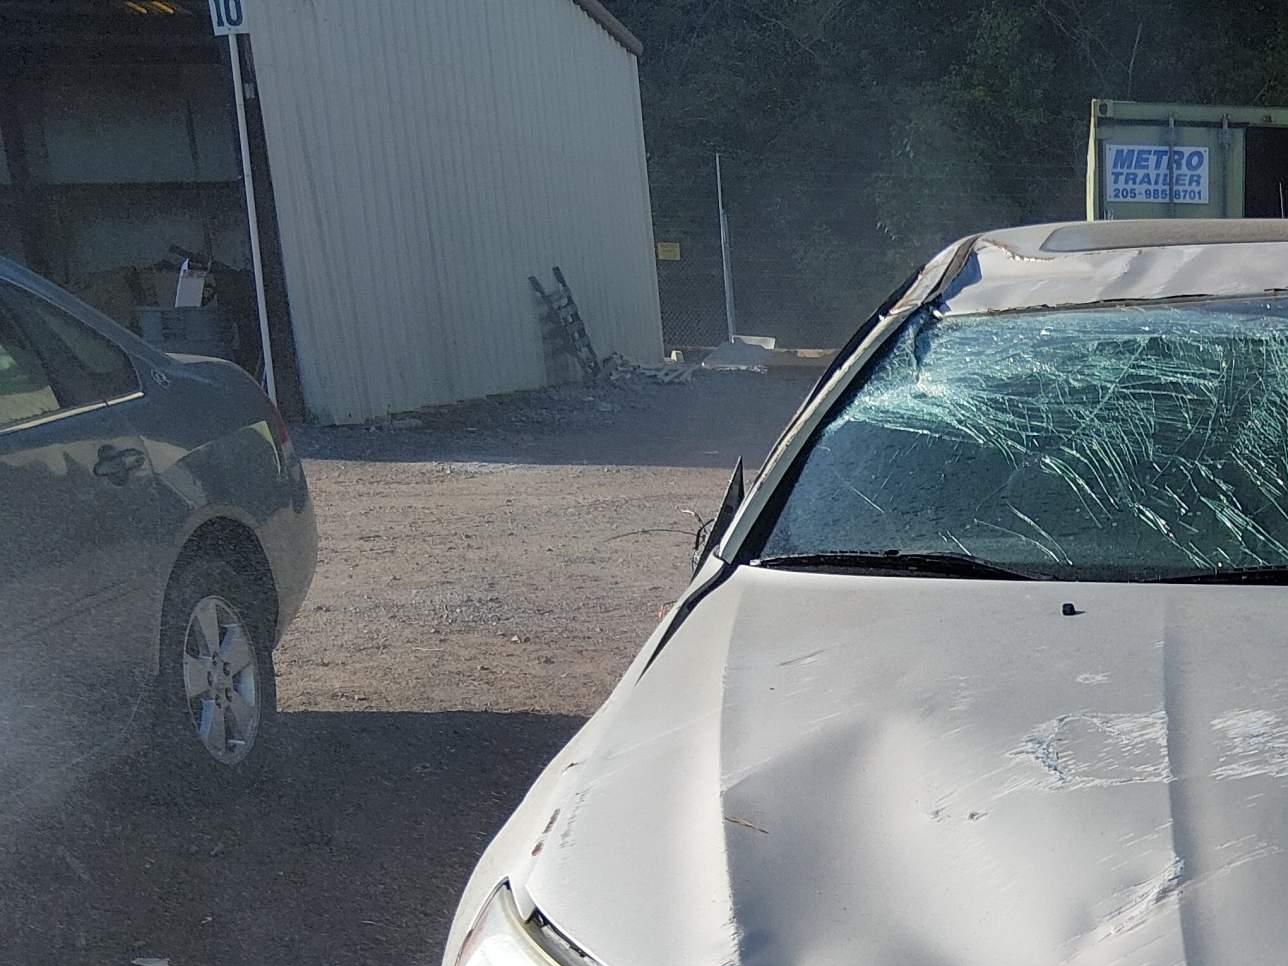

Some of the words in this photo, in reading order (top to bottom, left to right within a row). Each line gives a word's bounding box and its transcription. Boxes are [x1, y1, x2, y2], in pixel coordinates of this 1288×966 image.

[1112, 148, 1204, 172] METRO
[1111, 171, 1202, 187] TRAILER
[1113, 187, 1202, 200] 205-9858701
